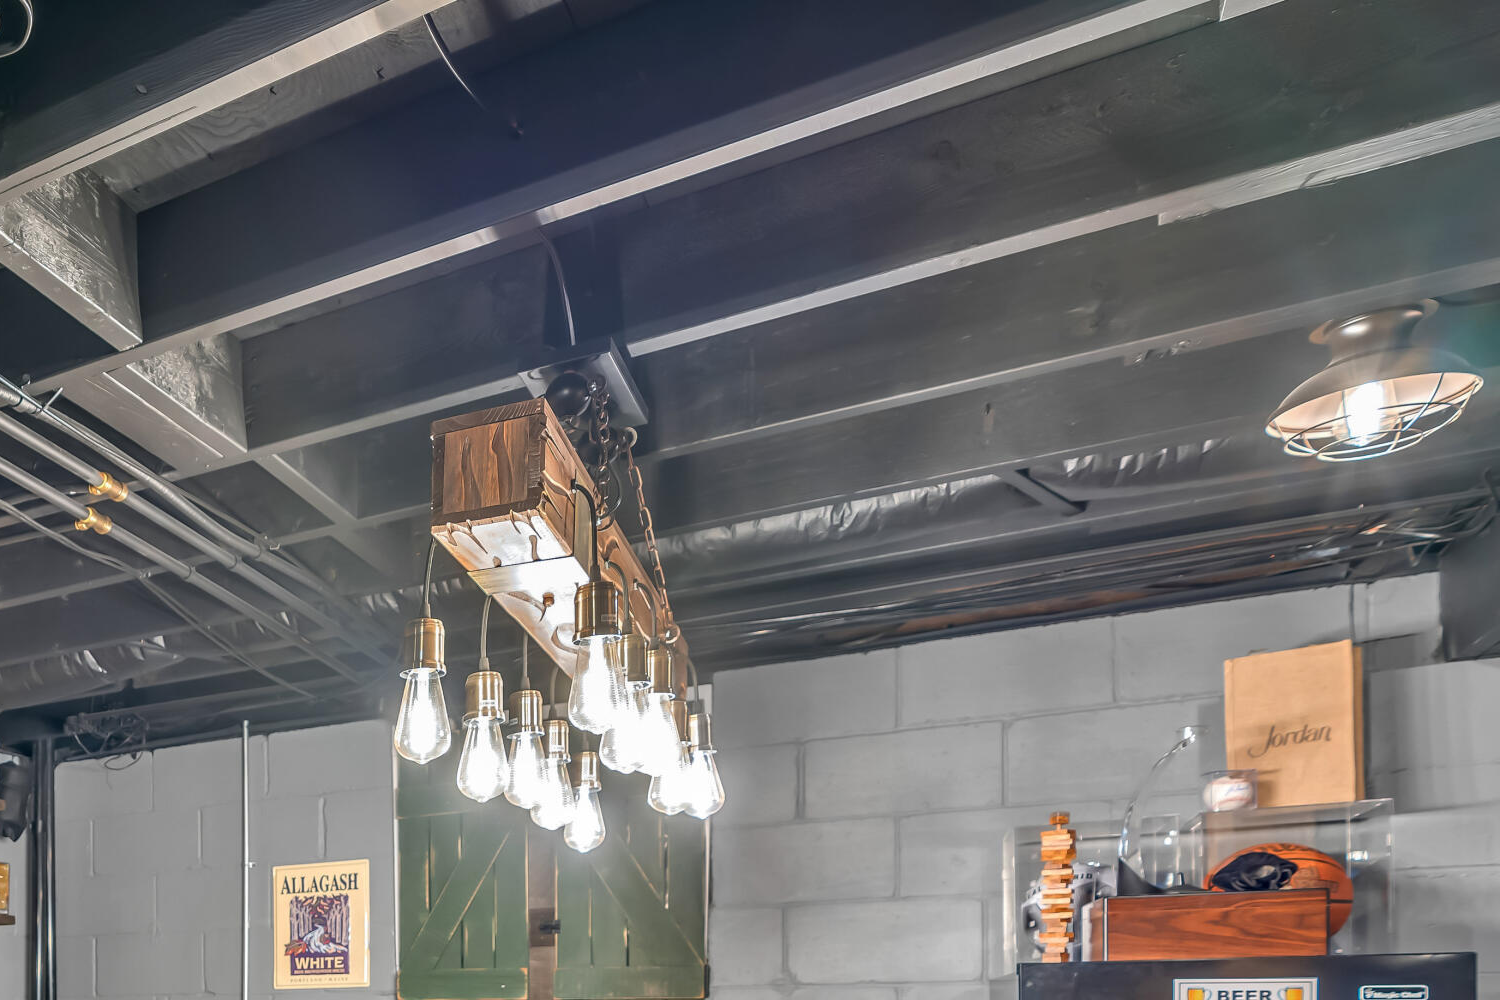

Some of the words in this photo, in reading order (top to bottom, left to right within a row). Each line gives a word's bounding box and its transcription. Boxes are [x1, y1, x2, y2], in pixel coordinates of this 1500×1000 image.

[1247, 724, 1332, 759] Jordan
[280, 873, 359, 895] ALLAGASH
[294, 956, 345, 969] WHITE
